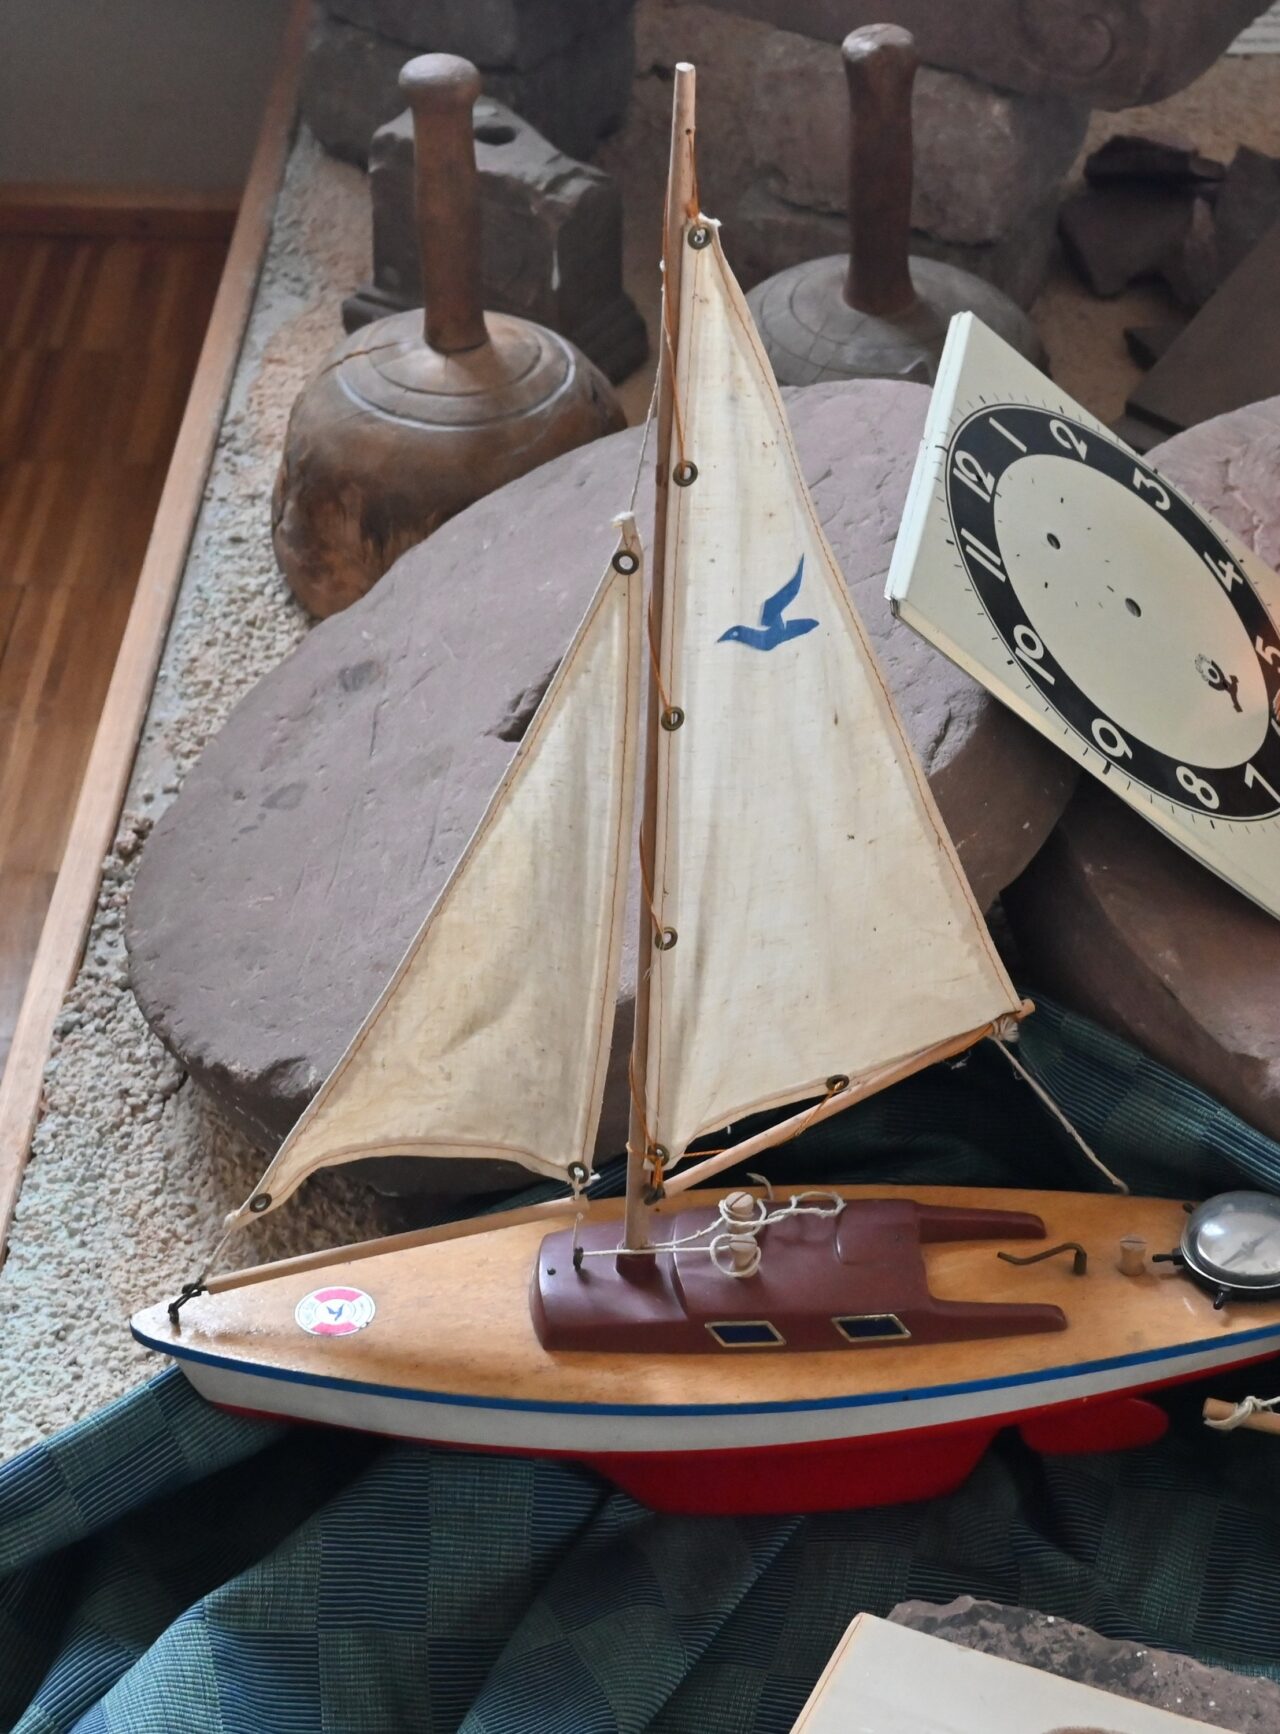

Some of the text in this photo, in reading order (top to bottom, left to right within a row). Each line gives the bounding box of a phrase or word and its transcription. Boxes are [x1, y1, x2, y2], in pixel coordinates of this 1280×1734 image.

[988, 416, 1028, 453] 1
[1049, 419, 1088, 461] 2
[952, 449, 997, 503] 12
[1132, 467, 1172, 511] 3
[959, 527, 1007, 583] 11
[1204, 551, 1244, 593] 4
[1012, 623, 1056, 686] 10
[1091, 717, 1134, 760] 9
[1175, 765, 1220, 809] 8
